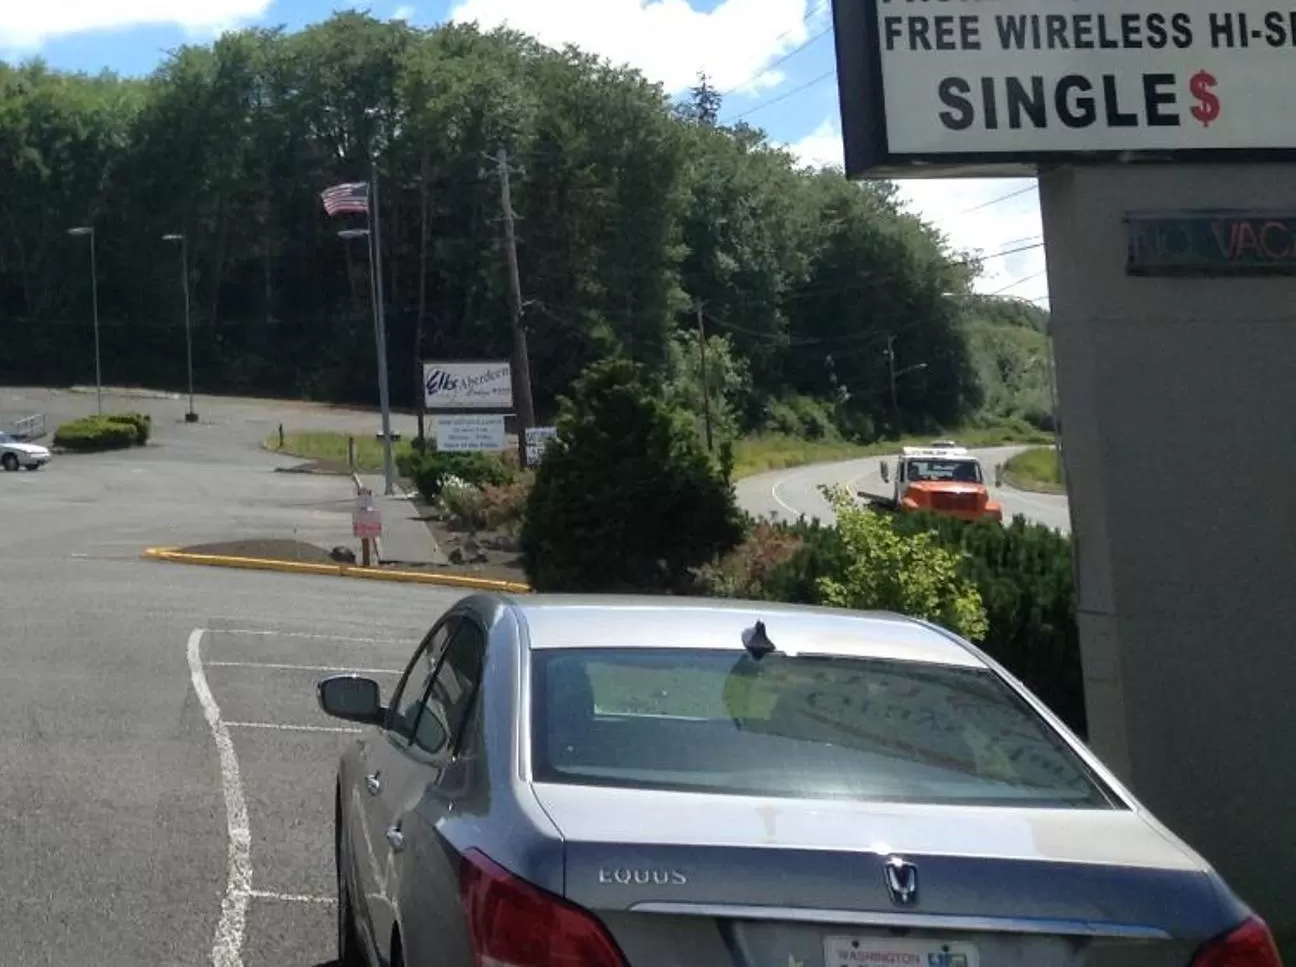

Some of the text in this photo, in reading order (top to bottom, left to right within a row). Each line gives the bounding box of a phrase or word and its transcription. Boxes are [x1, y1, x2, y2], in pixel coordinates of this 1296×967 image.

[884, 15, 982, 51] FREE
[995, 12, 1194, 51] WIRELESS
[1210, 220, 1296, 261] VAC
[598, 868, 687, 885] EQUUS
